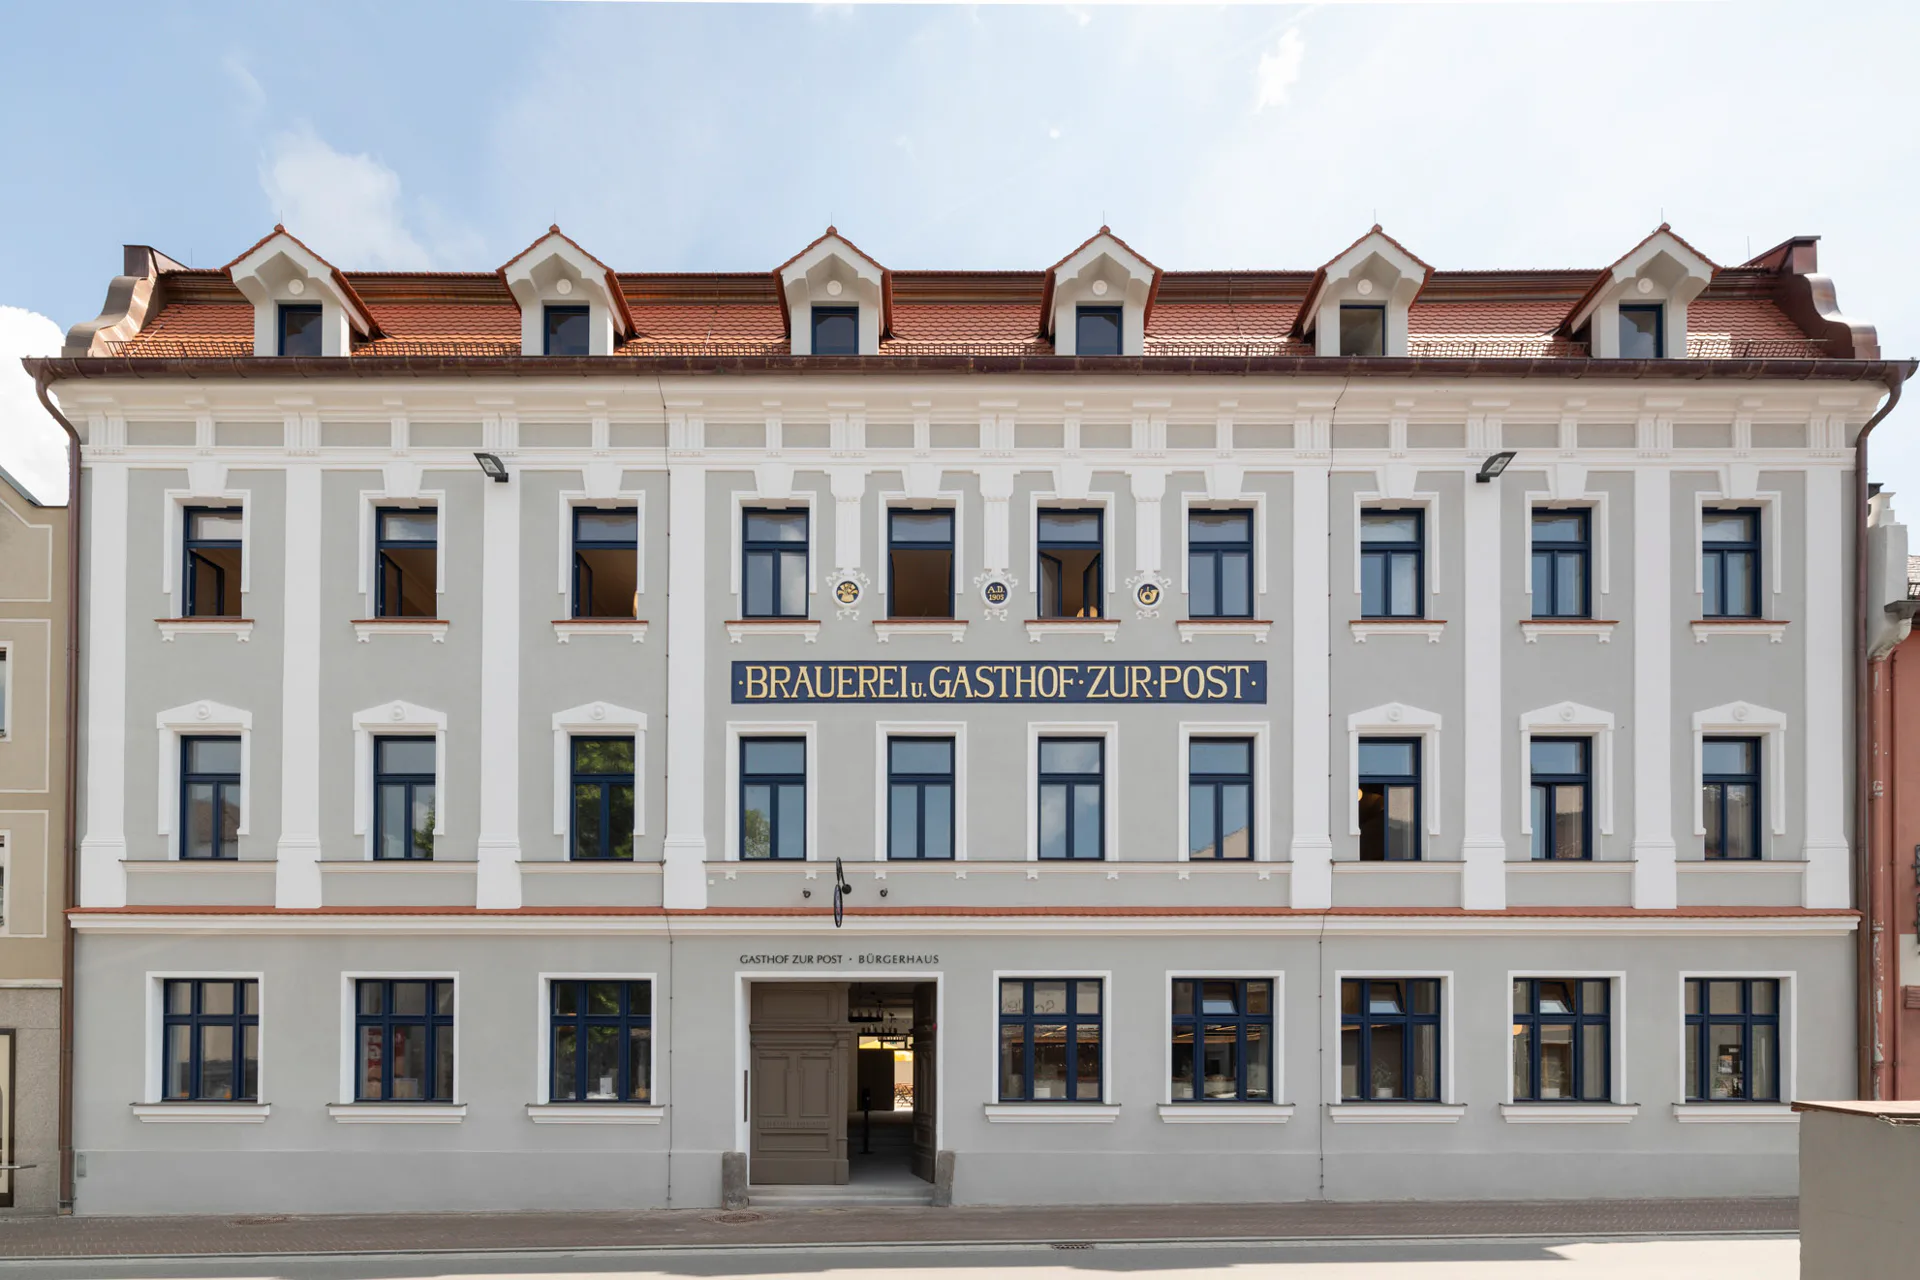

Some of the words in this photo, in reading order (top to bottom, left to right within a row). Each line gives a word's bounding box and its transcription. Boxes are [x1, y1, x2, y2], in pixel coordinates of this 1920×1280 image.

[987, 585, 1005, 594] A.D.
[745, 665, 908, 699] BRAUEREI
[929, 665, 1078, 699] GASTHOF
[1086, 665, 1152, 699] ZUR
[1160, 665, 1249, 700] POST
[740, 954, 789, 965] GASTHOF
[792, 954, 813, 965] ZUR
[816, 954, 843, 965] POST
[859, 952, 939, 965] BÜRGERHAUS
